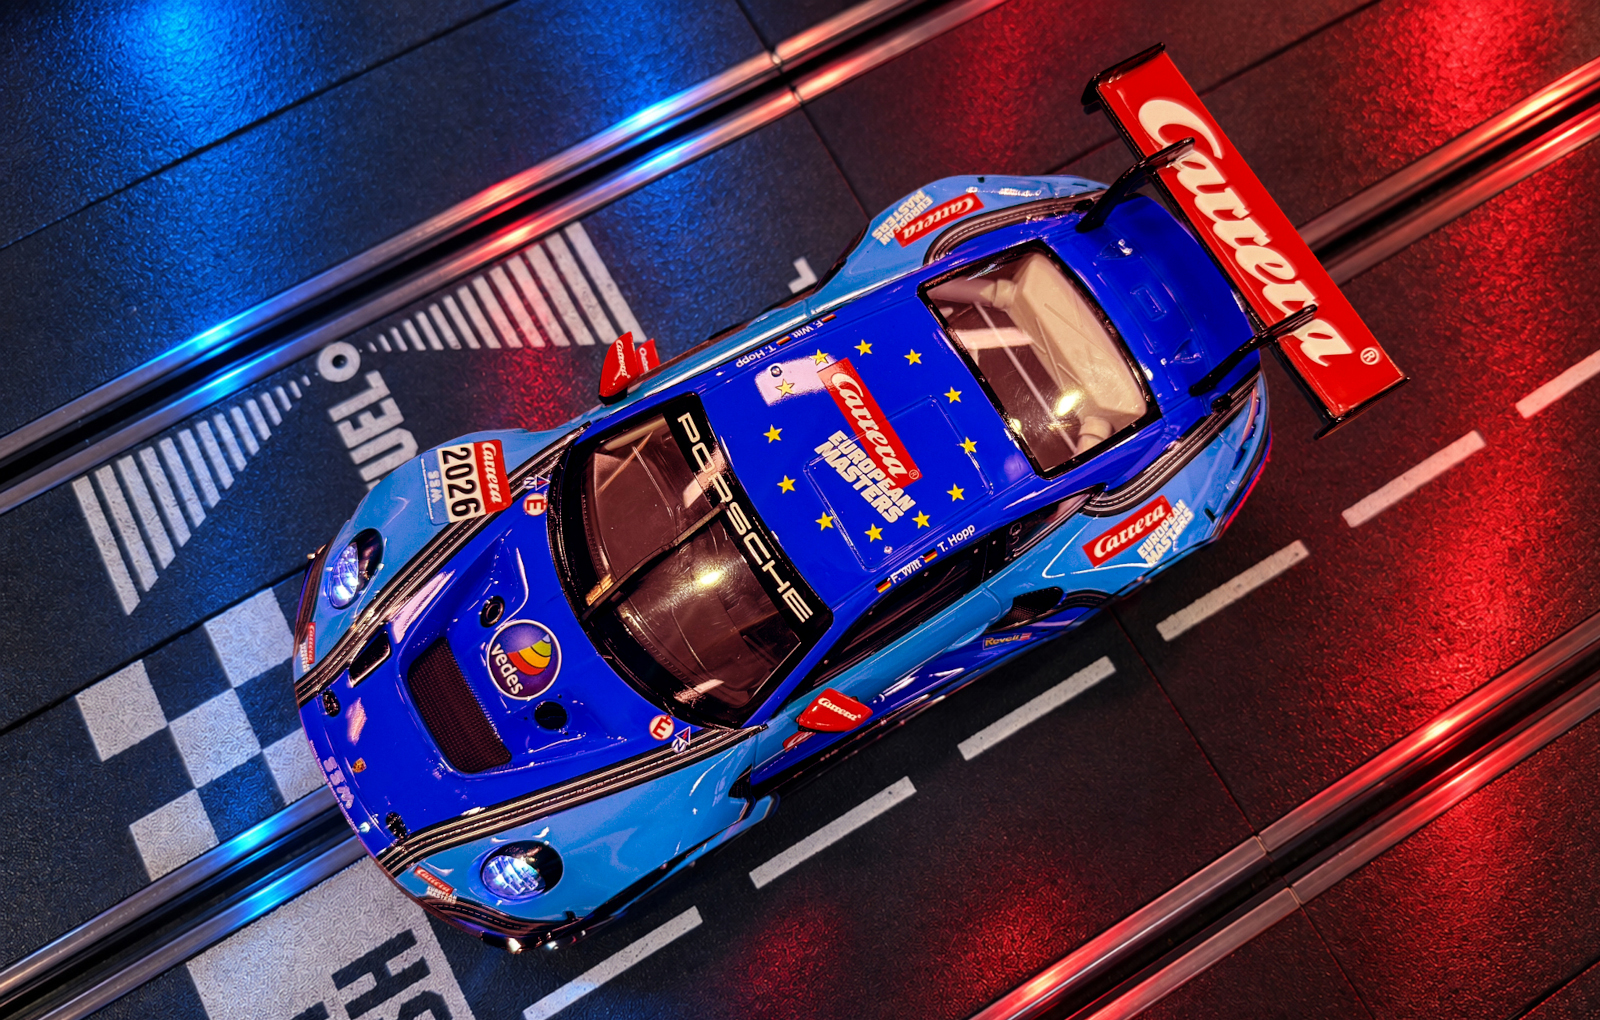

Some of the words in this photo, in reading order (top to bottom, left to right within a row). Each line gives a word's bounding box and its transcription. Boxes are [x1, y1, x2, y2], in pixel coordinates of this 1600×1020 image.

[871, 190, 926, 240] MASTERS
[879, 194, 934, 246] EUROPEAN
[903, 197, 974, 240] Carrera
[1138, 99, 1353, 367] Carrera
[735, 349, 766, 368] Hopp
[765, 344, 777, 353] T.
[328, 370, 419, 490] UEL
[831, 372, 908, 479] Carrera
[441, 446, 482, 517] 2026
[481, 442, 502, 504] Carrera
[814, 441, 905, 523] MASTERS
[828, 429, 917, 512] EUROPEAN
[677, 412, 814, 623] PORSCHE
[1093, 503, 1166, 558] Carrera
[1136, 499, 1187, 560] EUROPEAN
[1145, 507, 1195, 568] MASTERS
[900, 558, 923, 576] Witt
[937, 541, 949, 552] T.
[947, 524, 976, 547] Hopp
[491, 643, 524, 695] vedes
[985, 634, 1020, 647] Revell
[818, 697, 857, 721] Carrera
